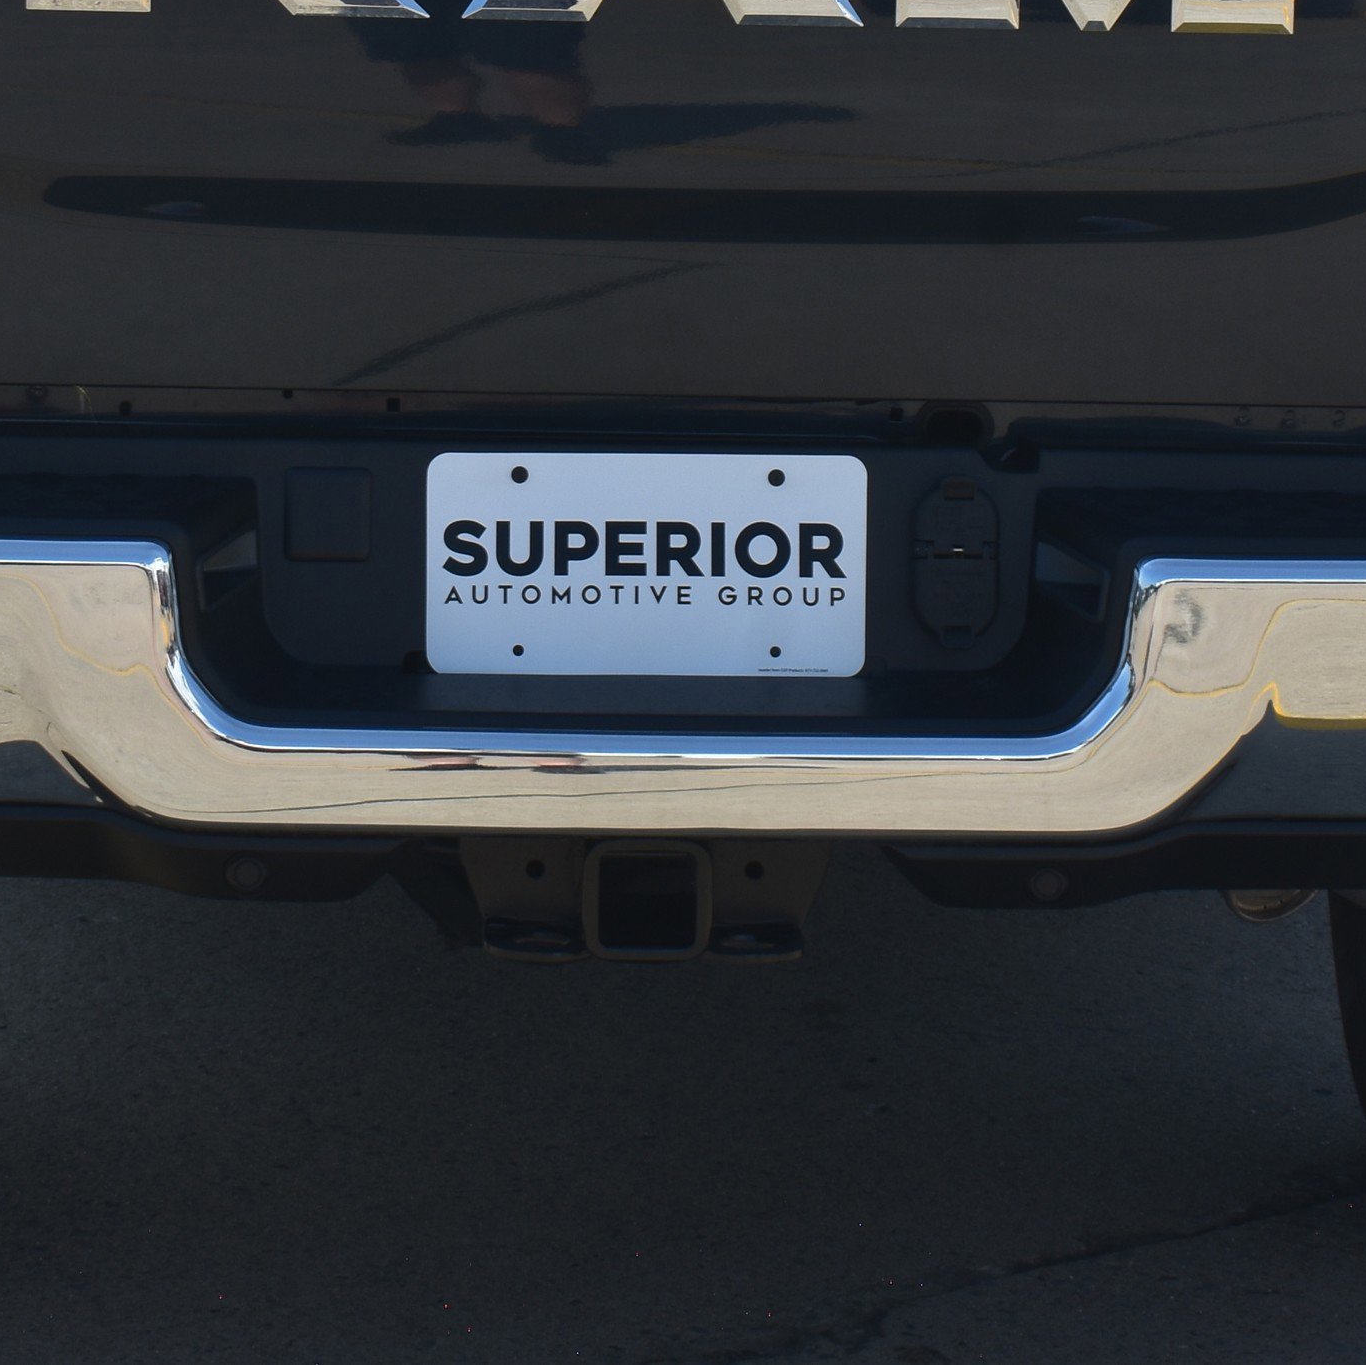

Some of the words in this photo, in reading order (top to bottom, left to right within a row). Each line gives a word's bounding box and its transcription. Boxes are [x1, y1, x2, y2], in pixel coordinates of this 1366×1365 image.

[442, 519, 848, 579] SUPERIOR
[444, 584, 692, 606] AUTOMOTIVE
[718, 586, 847, 607] GROUP
